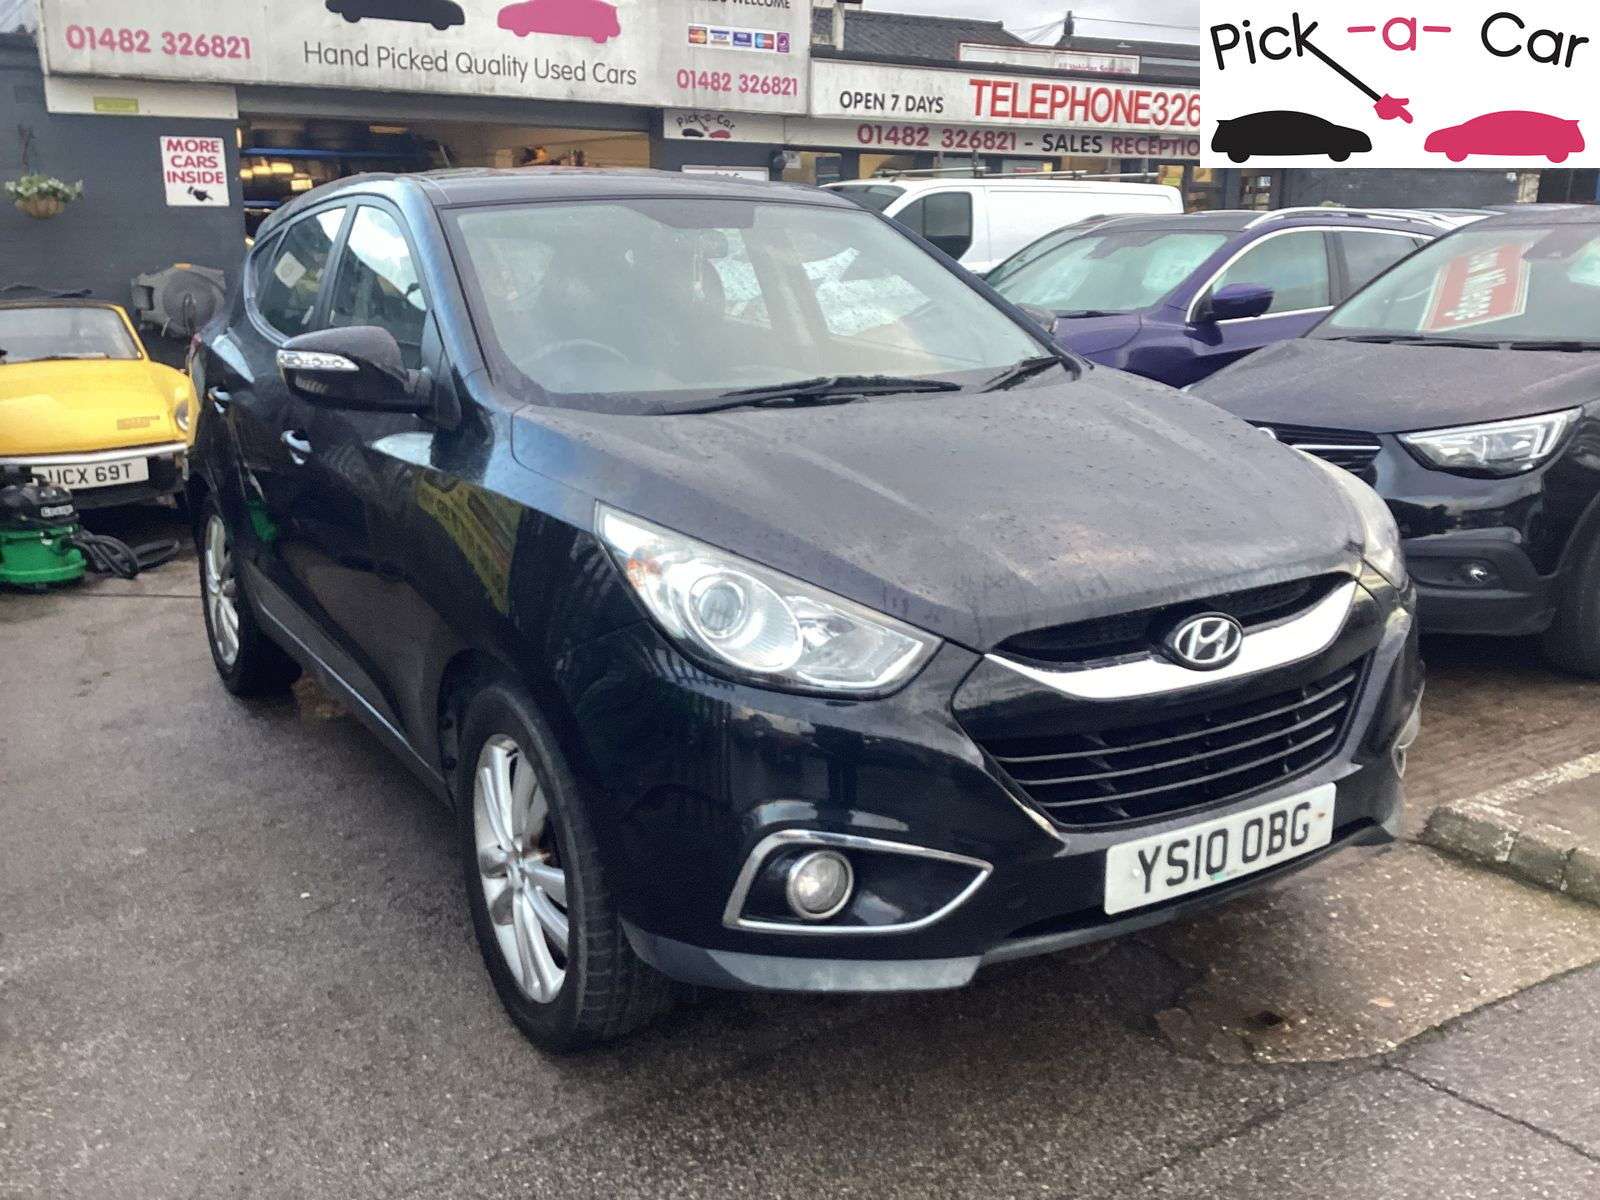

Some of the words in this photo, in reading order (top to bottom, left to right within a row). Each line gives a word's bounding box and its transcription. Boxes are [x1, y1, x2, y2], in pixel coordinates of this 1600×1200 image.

[65, 24, 151, 53] 01482
[161, 31, 251, 60] 326821
[304, 41, 369, 67] Hand
[377, 46, 448, 73] Picked
[455, 52, 528, 83] Quality
[534, 57, 586, 82] Used
[592, 62, 637, 86] Cars
[677, 69, 732, 92] 01482
[738, 73, 798, 96] 326821
[839, 90, 885, 111] OPEN
[891, 94, 900, 111] 7
[905, 95, 944, 113] DAYS
[166, 138, 220, 153] MORE
[857, 123, 930, 147] 01482
[941, 128, 1017, 151] 326821
[1041, 133, 1103, 153] SALES
[171, 155, 218, 169] CARS
[166, 170, 224, 184] INSIDE
[95, 463, 132, 483] 69T
[1137, 828, 1229, 893] YS10
[1242, 802, 1312, 864] OBG
